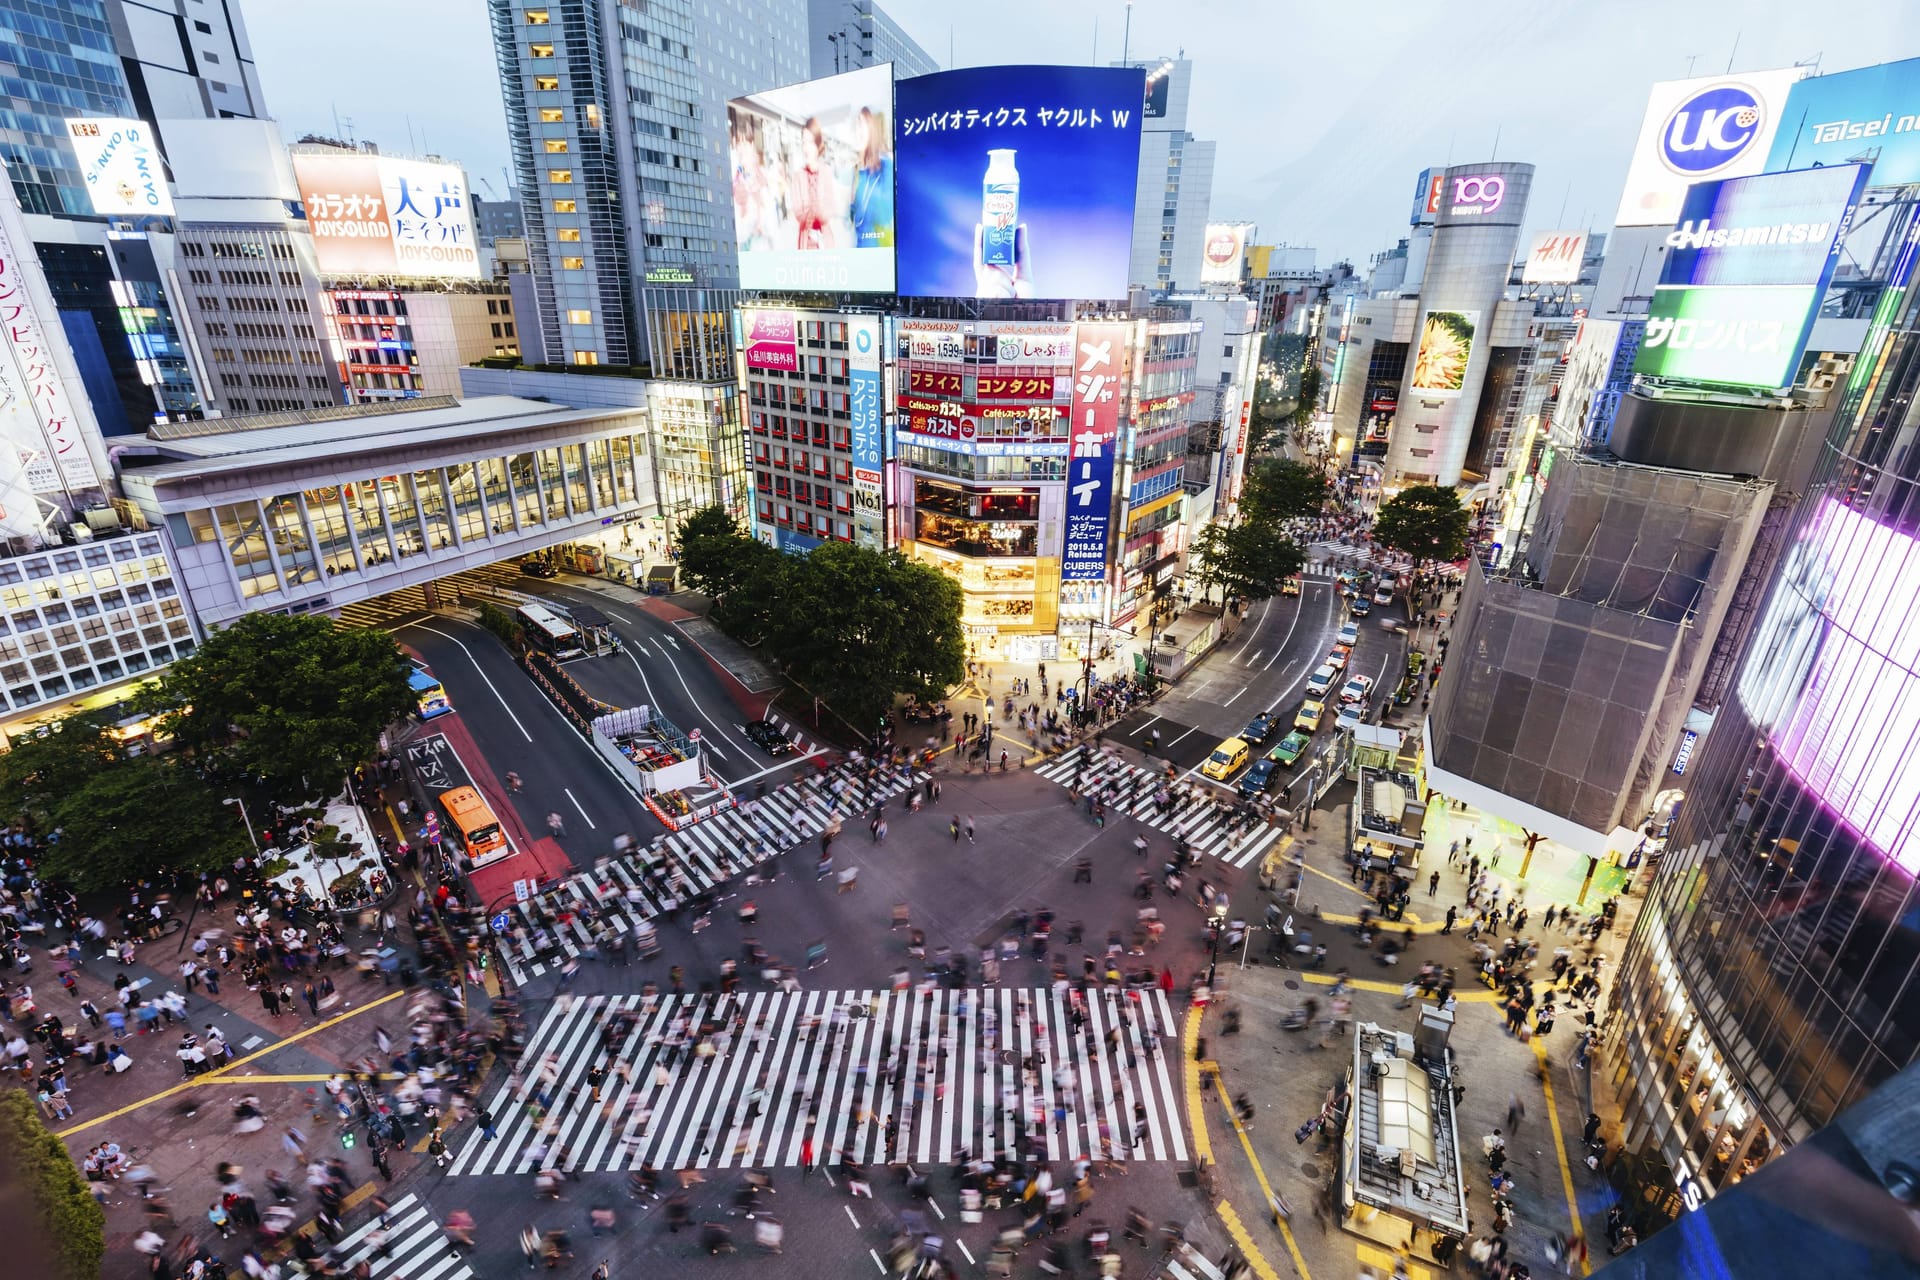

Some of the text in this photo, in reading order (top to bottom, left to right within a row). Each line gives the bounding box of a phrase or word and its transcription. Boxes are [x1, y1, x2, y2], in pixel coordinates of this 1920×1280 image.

[903, 106, 1130, 136] シンバイオティクス ヤクルト W
[1812, 112, 1893, 144] Taisei
[87, 131, 122, 184] SANKYO
[126, 128, 159, 206] SANKYO
[390, 176, 461, 219] 大声
[1454, 176, 1505, 213] 109
[308, 193, 382, 219] カラオケ
[1451, 205, 1483, 216] SHIBUYA
[314, 220, 390, 238] JOYSOUND
[1666, 219, 1830, 249] Hisamitsu
[1830, 205, 1856, 256] サロンパス
[400, 244, 474, 262] JOYSOUND
[1535, 236, 1581, 261] H&M
[646, 272, 692, 280] MARK CITY
[335, 291, 360, 300] カラオケ
[767, 328, 790, 338] クリニック
[1644, 316, 1783, 353] サロンパス
[899, 339, 909, 349] 9F
[754, 350, 794, 366] 品川美容外科
[911, 373, 961, 391] プライス
[978, 379, 1051, 395] コンタクト
[940, 401, 965, 418] ガスト
[1027, 406, 1062, 420] ガスト
[853, 379, 867, 461] アイシティ
[867, 380, 878, 463] コンタクトの
[899, 415, 910, 426] 7F
[927, 416, 958, 436] ガスト
[1072, 340, 1117, 506] メジャーボーイ
[855, 489, 881, 511] No.1
[1070, 521, 1104, 532] メジャー
[1067, 543, 1104, 551] 2019.5.8
[1067, 550, 1103, 558] Release
[1063, 561, 1105, 570] CUBERS
[1157, 563, 1175, 582] LUSH
